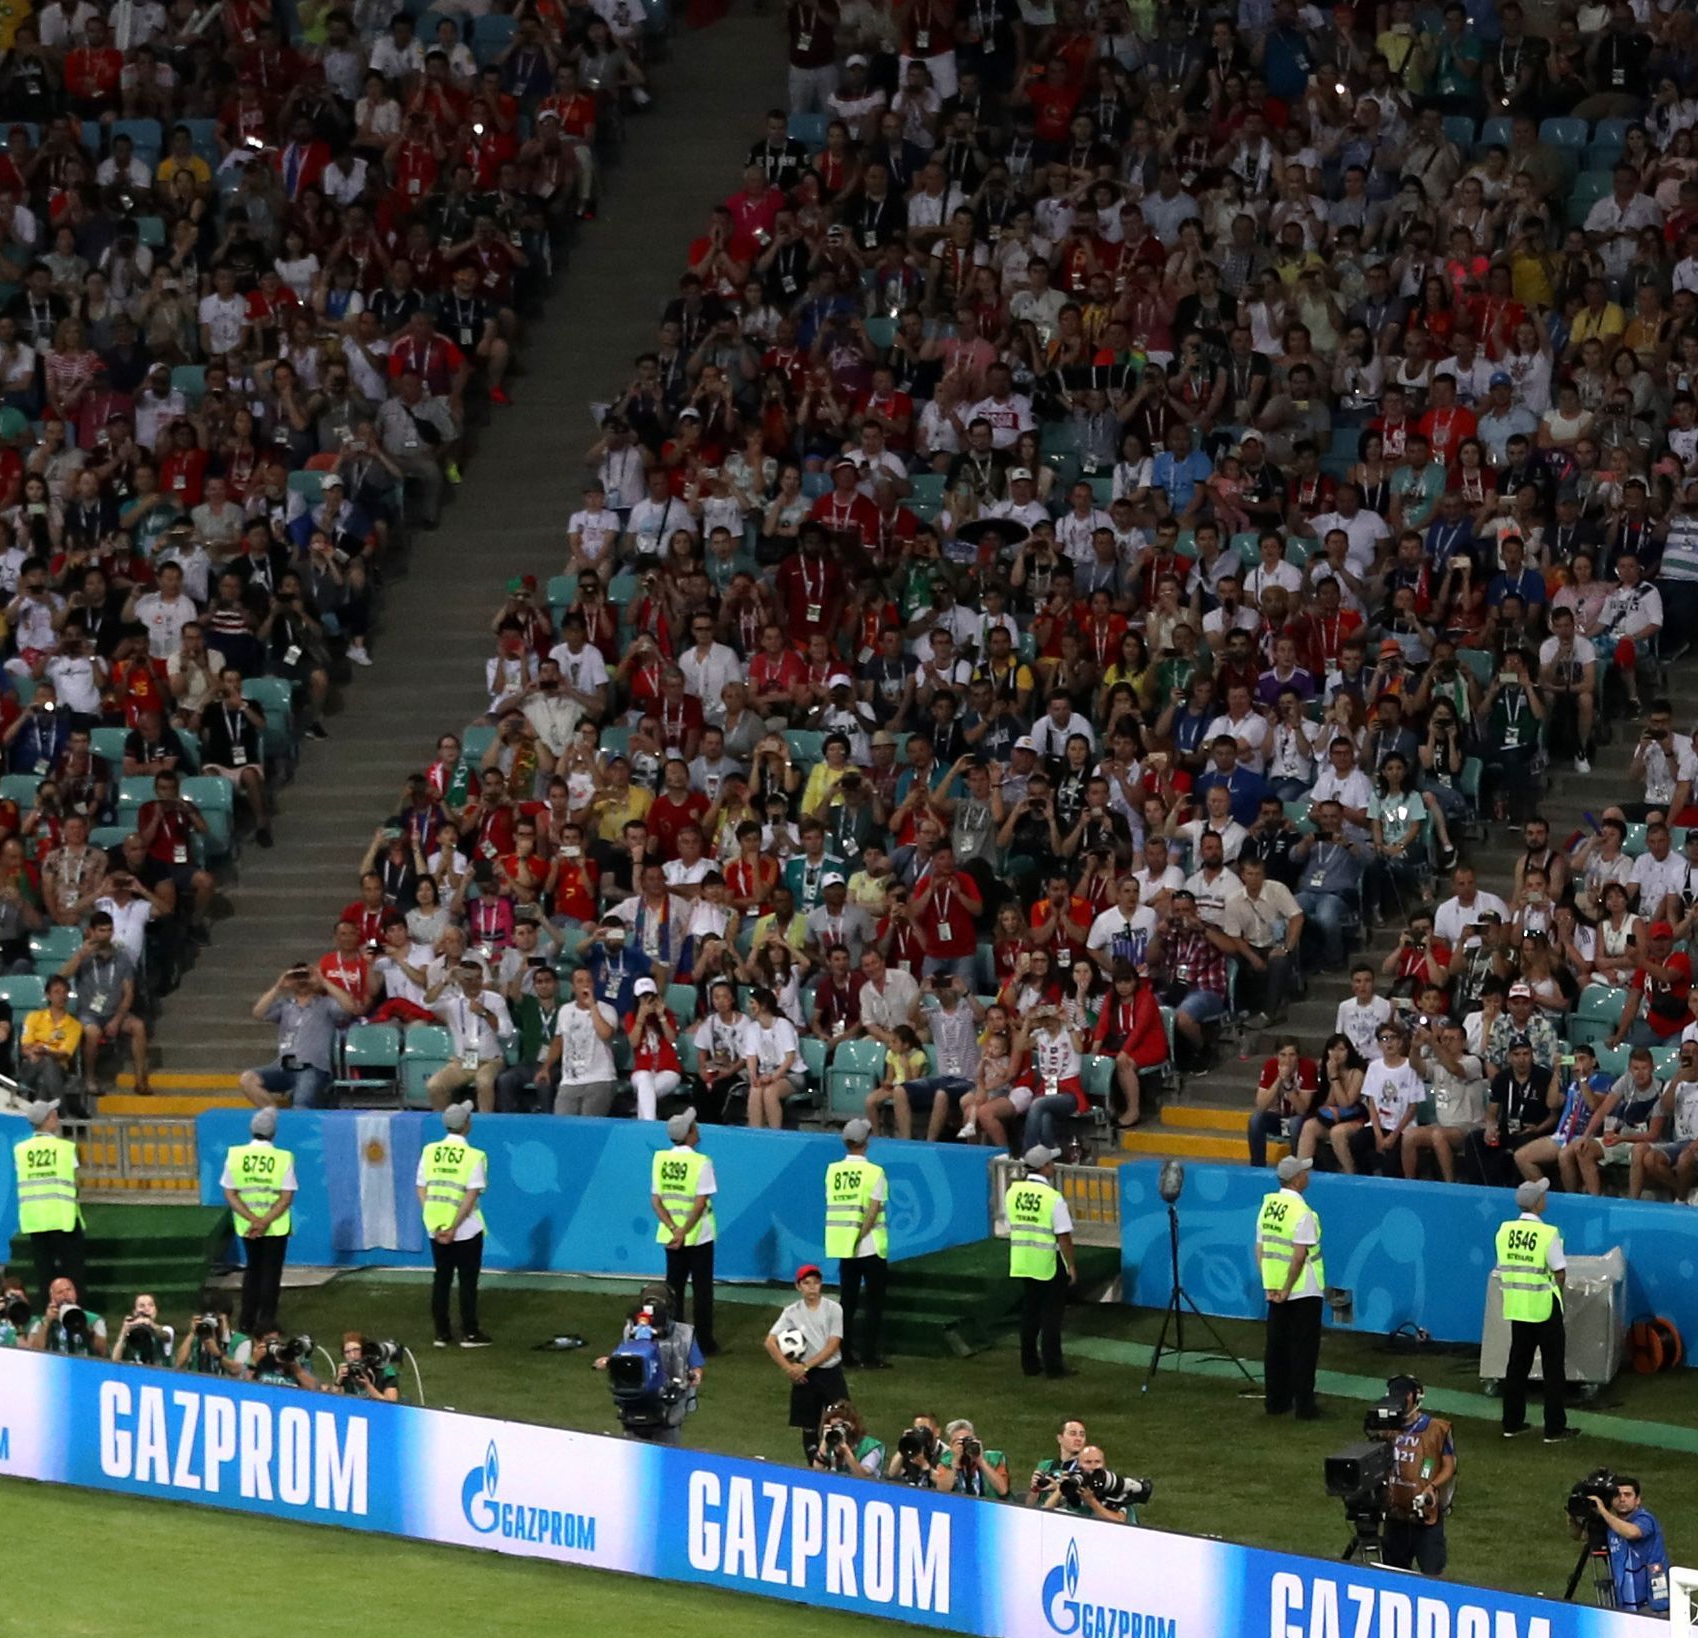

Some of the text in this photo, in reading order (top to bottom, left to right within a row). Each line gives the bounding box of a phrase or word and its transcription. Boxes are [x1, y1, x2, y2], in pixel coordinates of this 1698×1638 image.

[27, 1150, 57, 1168] 9221
[242, 1155, 275, 1173] 8750
[834, 1171, 862, 1190] 8766
[1507, 1230, 1538, 1251] 8546
[100, 1381, 368, 1515] GAZPROM
[501, 1505, 595, 1552] GAZPROM
[688, 1470, 950, 1614] GAZPROM
